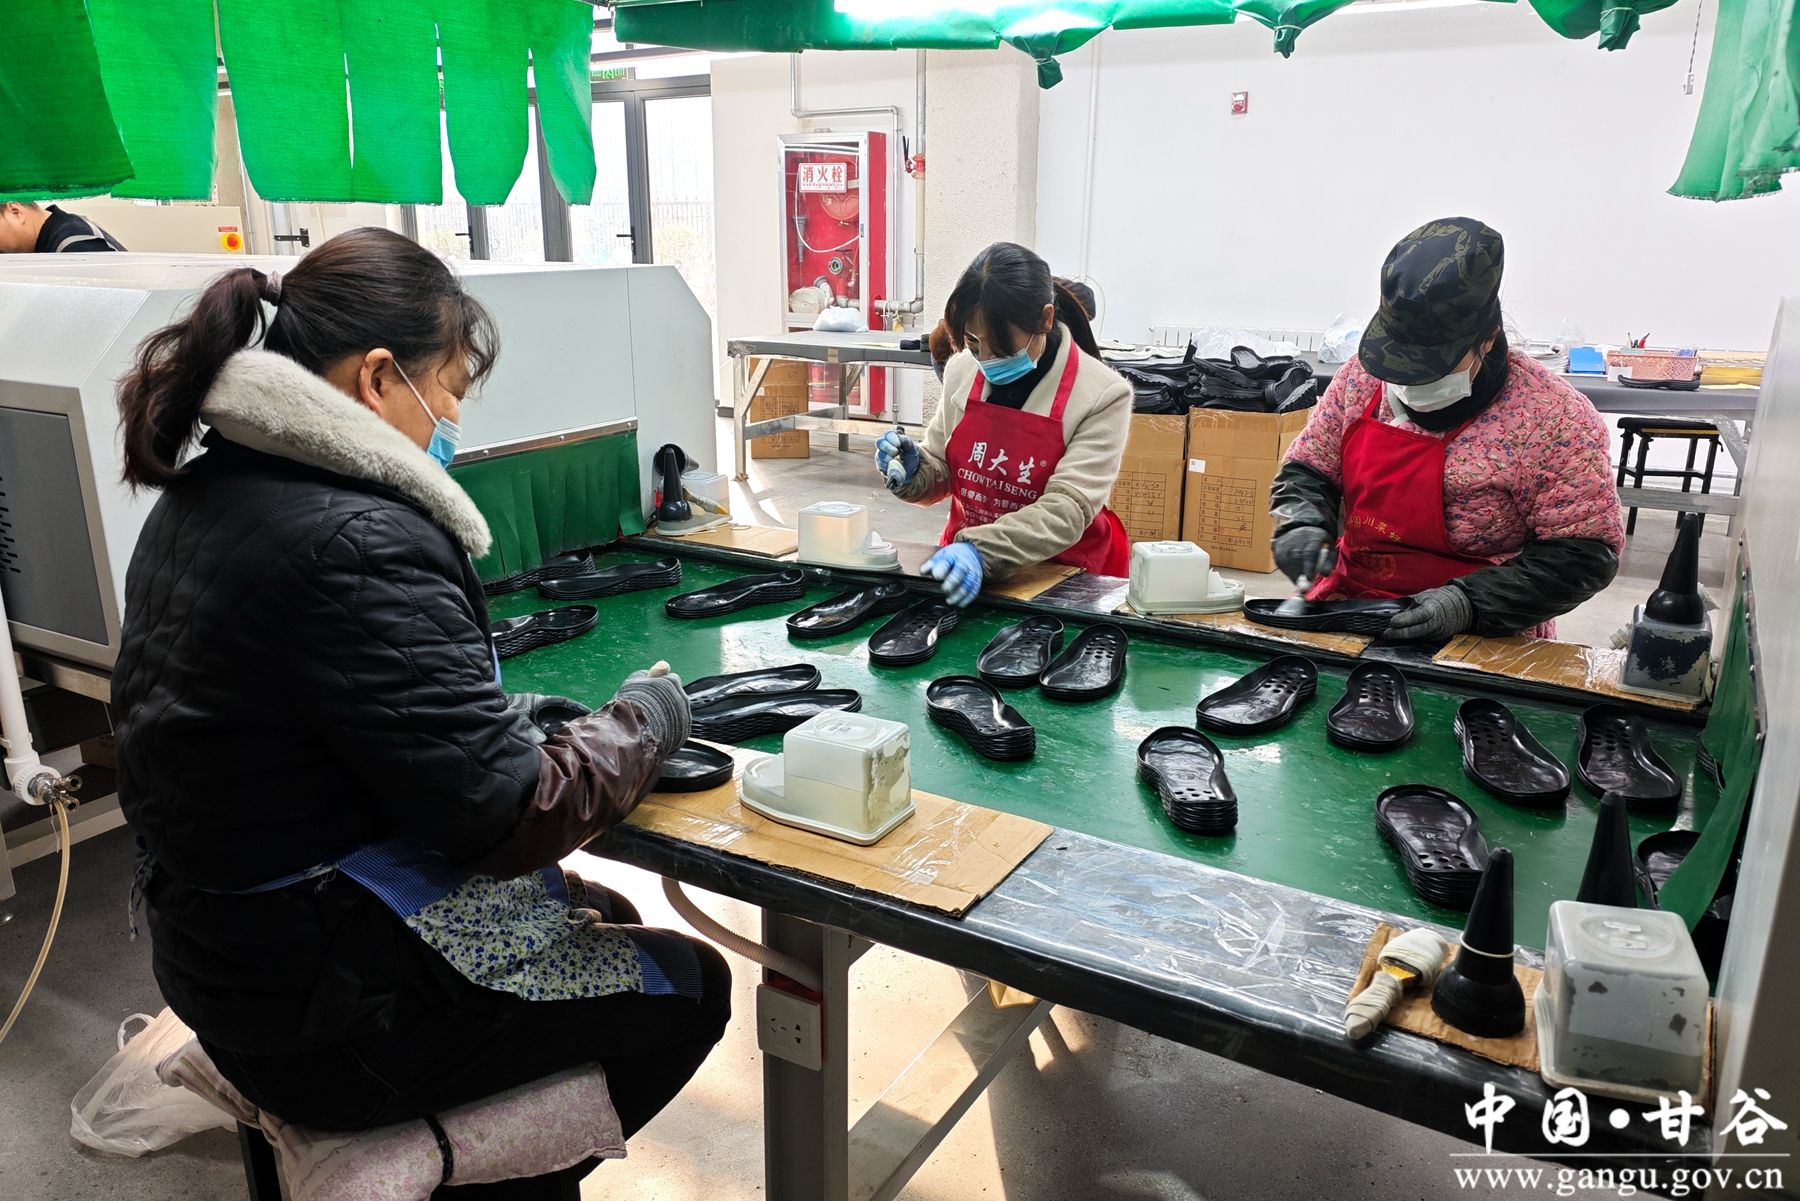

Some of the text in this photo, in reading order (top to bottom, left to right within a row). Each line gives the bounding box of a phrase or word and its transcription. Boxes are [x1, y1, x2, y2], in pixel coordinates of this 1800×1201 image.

[802, 165, 843, 183] 消火栓
[967, 441, 1035, 485] 周大生
